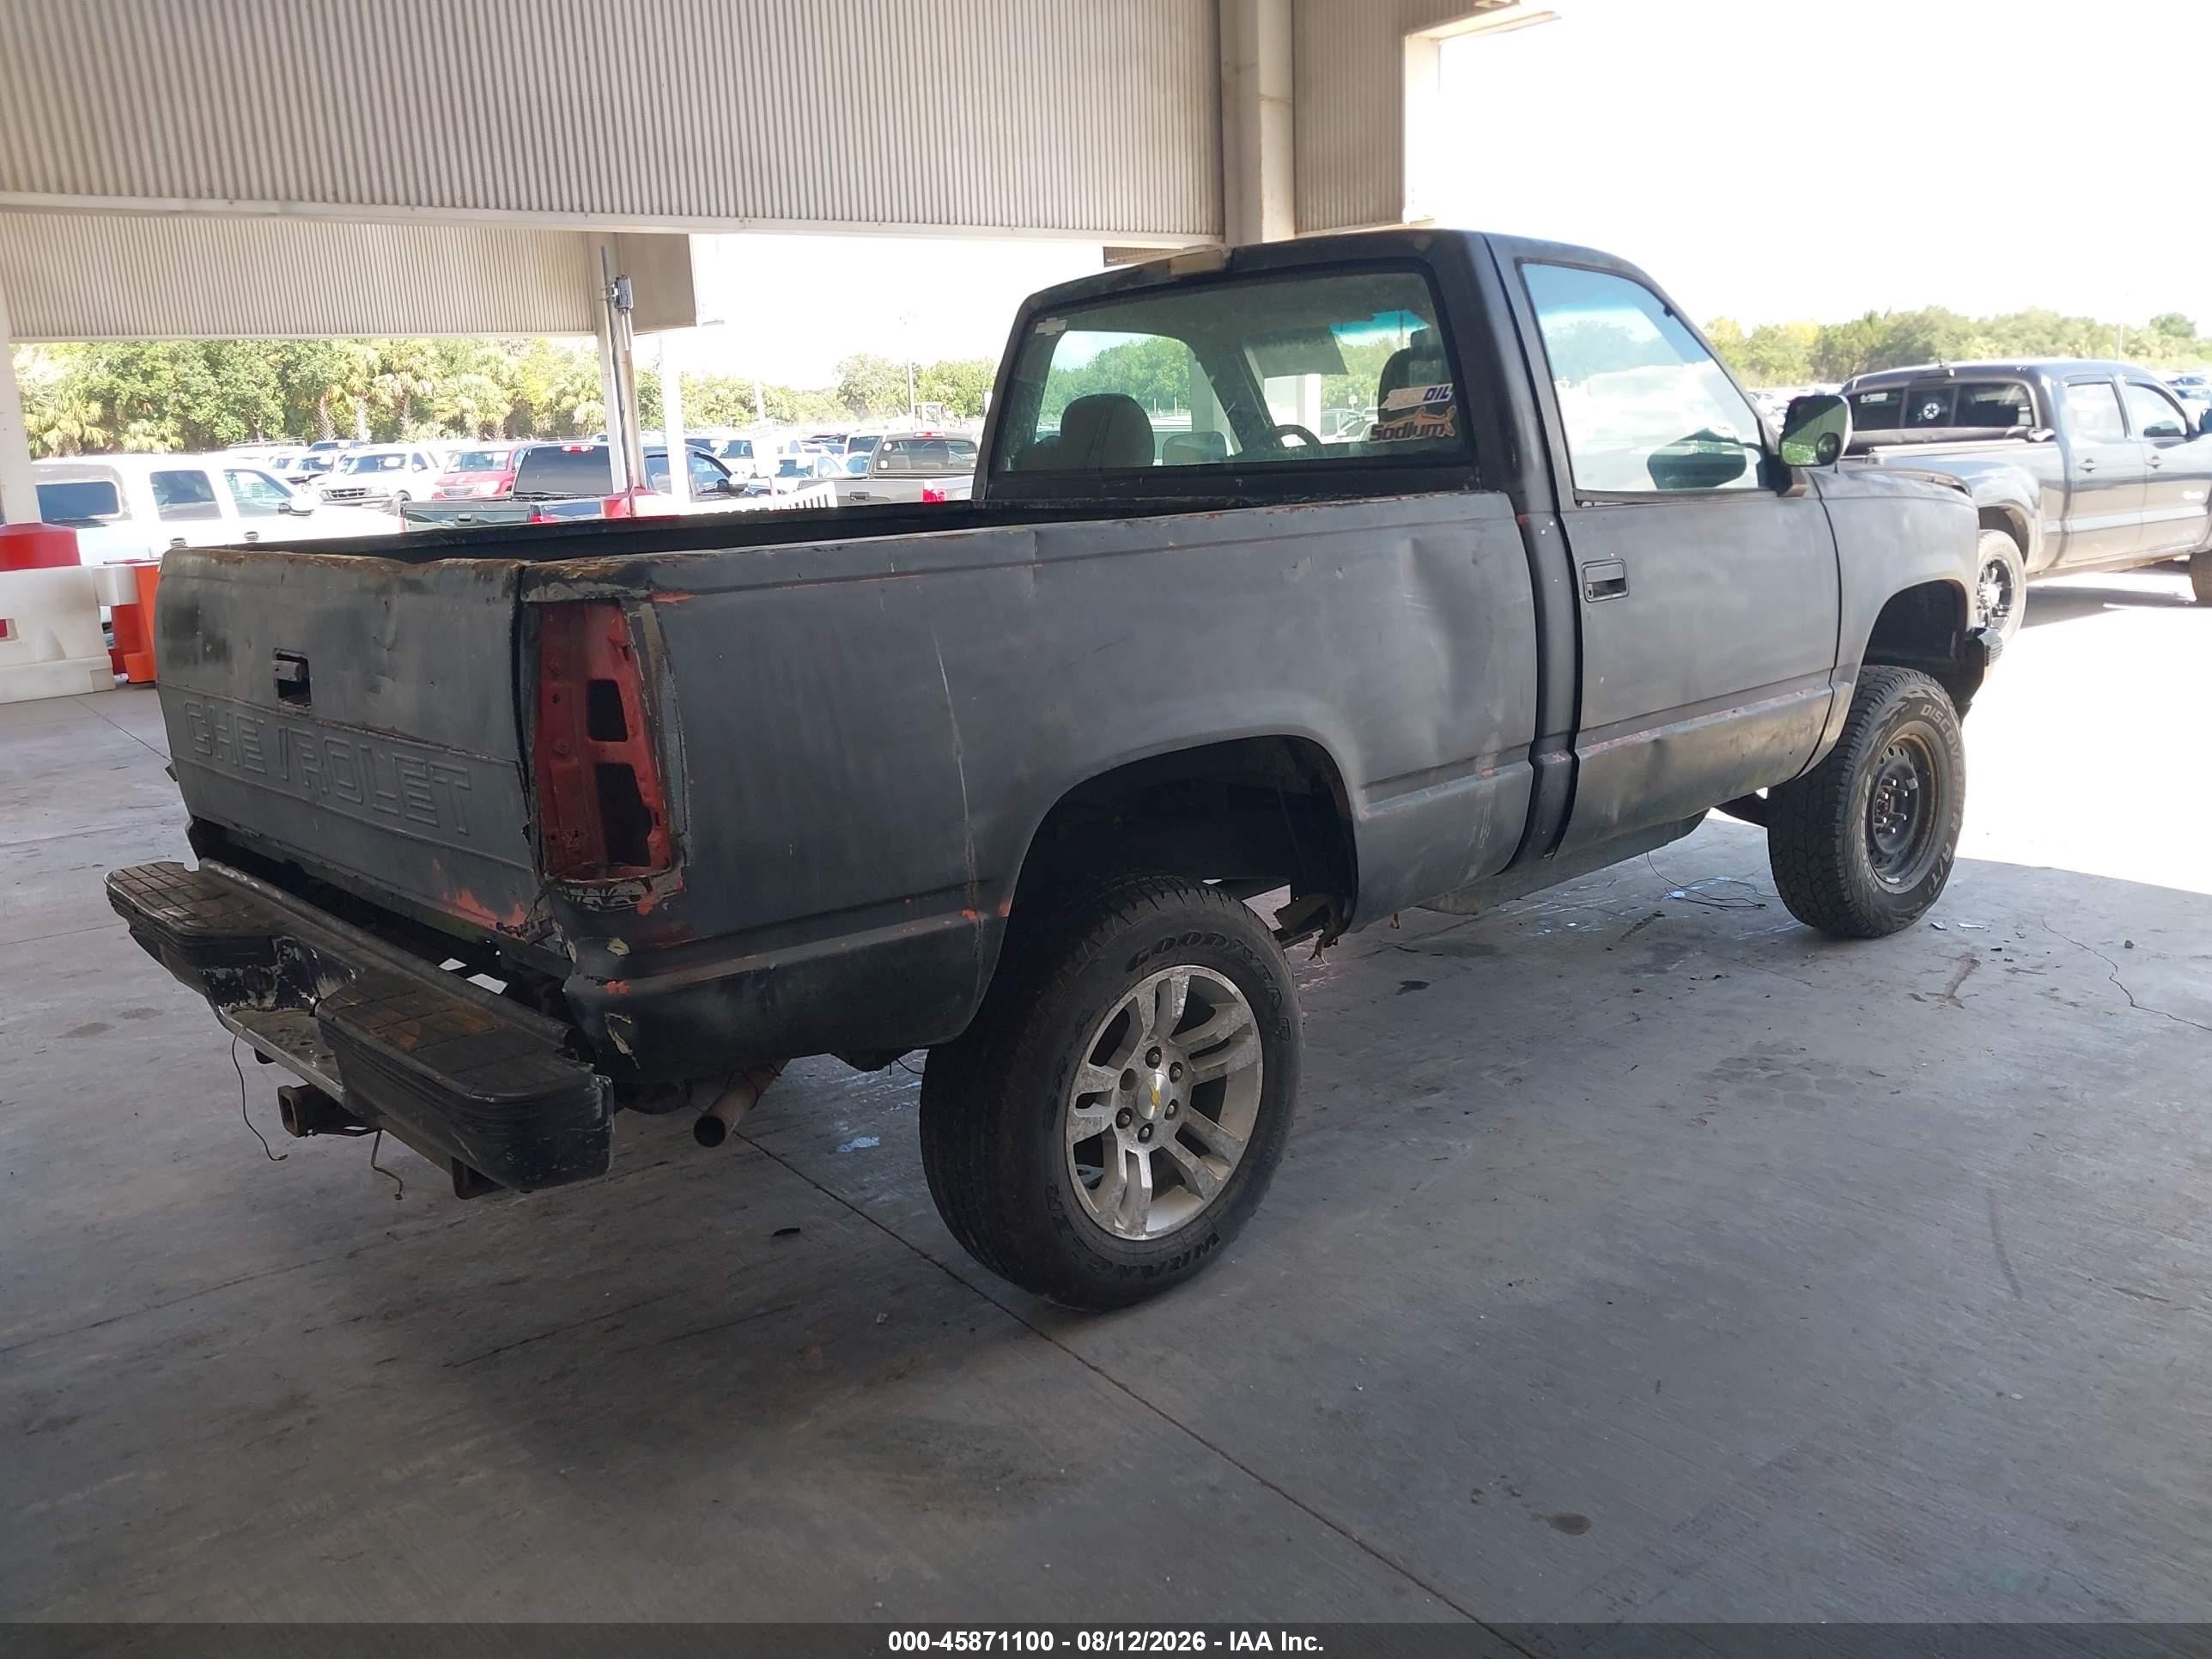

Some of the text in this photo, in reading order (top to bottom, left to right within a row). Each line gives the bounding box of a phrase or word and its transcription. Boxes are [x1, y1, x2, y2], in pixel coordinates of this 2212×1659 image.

[1423, 386, 1450, 401] OIL
[1370, 422, 1445, 441] Sodium
[1126, 932, 1291, 1042] GOODYEAR
